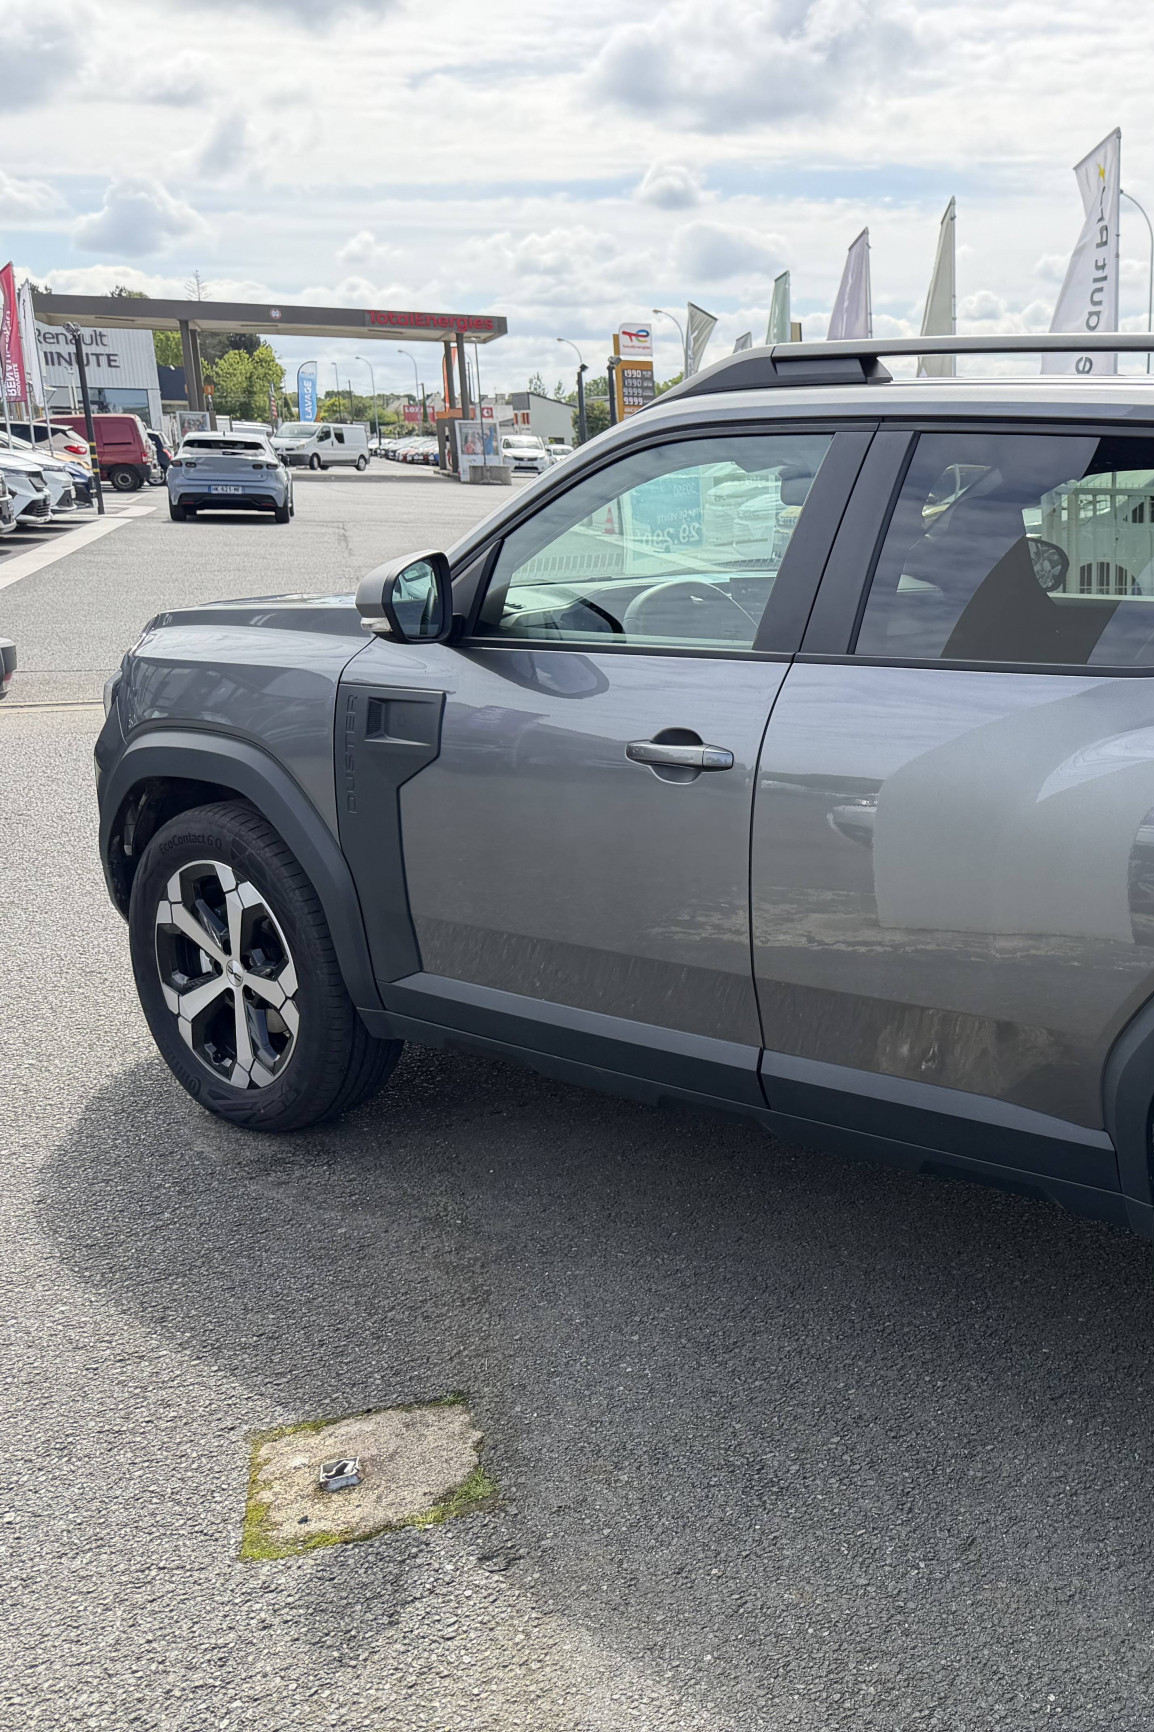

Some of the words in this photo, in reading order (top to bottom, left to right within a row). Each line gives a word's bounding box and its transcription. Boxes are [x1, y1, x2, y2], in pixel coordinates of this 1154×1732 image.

[367, 310, 494, 332] TotalEnergies
[304, 379, 313, 419] LAVAGE
[159, 832, 206, 855] EcoContact
